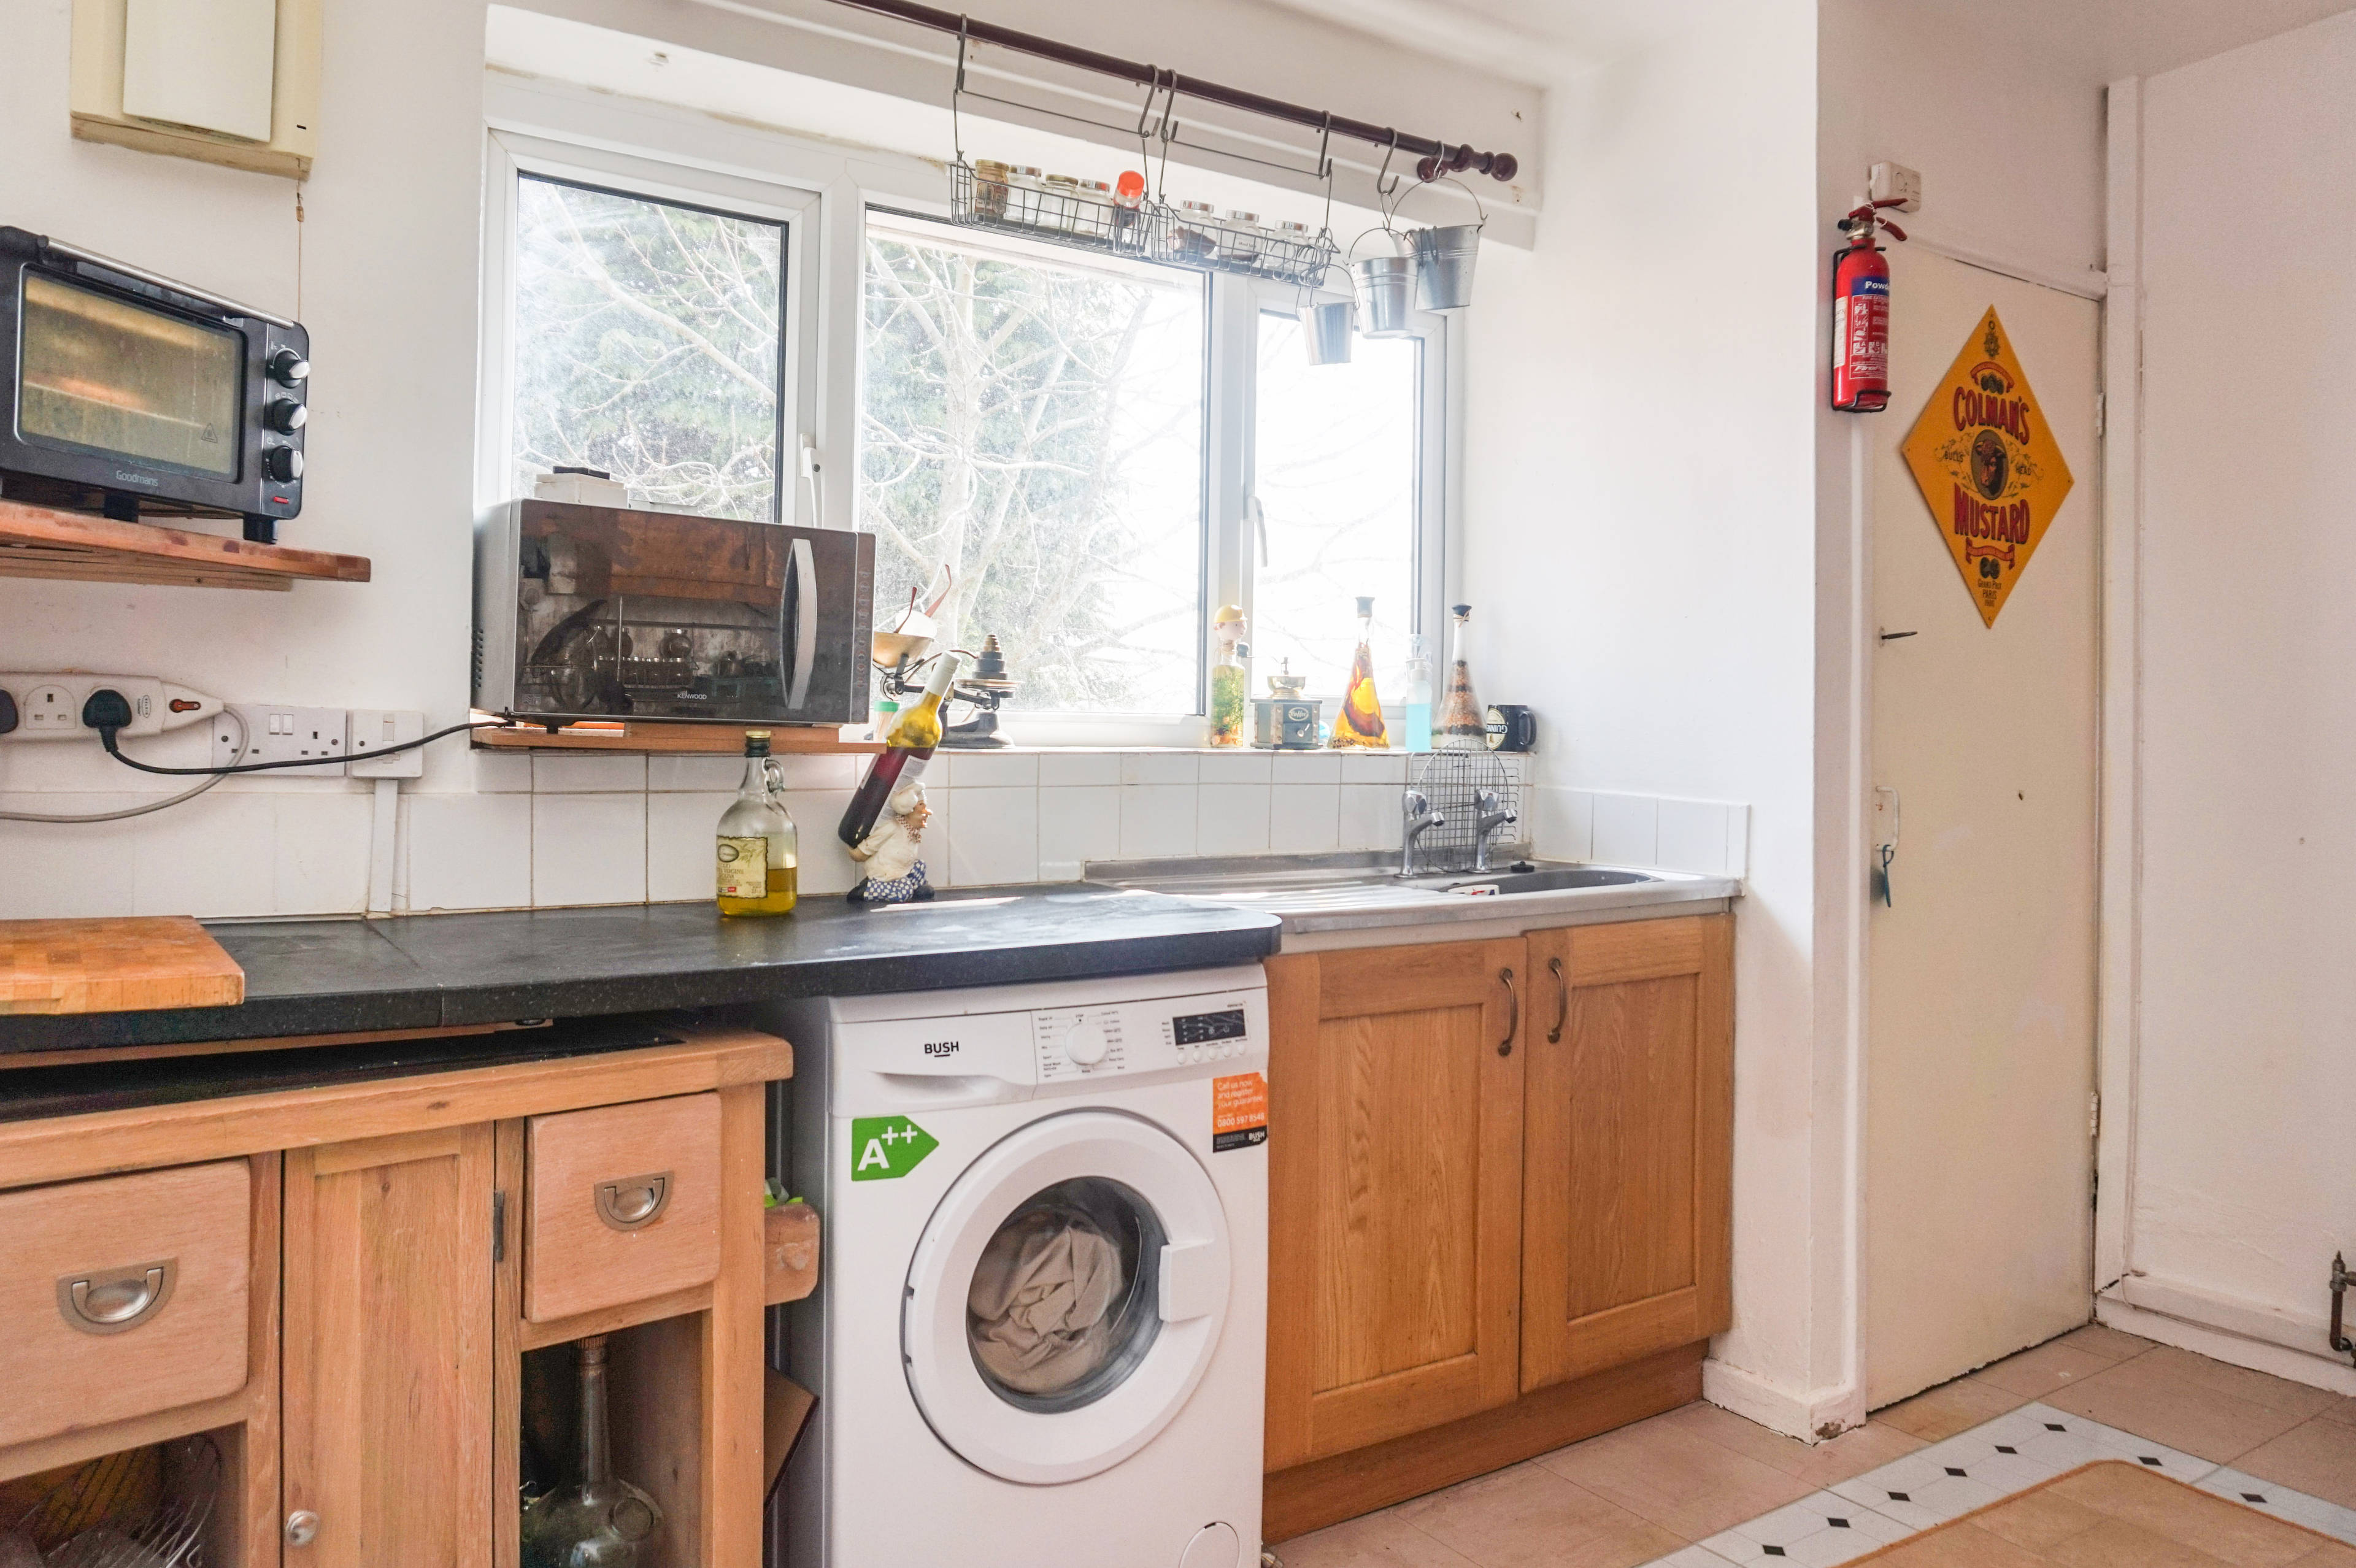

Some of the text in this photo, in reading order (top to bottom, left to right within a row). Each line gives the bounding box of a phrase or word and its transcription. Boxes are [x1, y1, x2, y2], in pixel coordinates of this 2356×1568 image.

[1954, 386, 2030, 445] COLMAN'S
[117, 470, 158, 486] Goodmans
[1954, 482, 2030, 545] MUSTARD
[924, 1041, 959, 1055] BUSH
[1217, 1082, 1230, 1091] Call
[1217, 1091, 1230, 1100] and
[1217, 1096, 1264, 1110] your guarantee
[1217, 1117, 1235, 1128] 0800
[1236, 1115, 1248, 1124] 597
[1249, 1131, 1265, 1140] BUSH
[857, 1124, 918, 1172] A++
